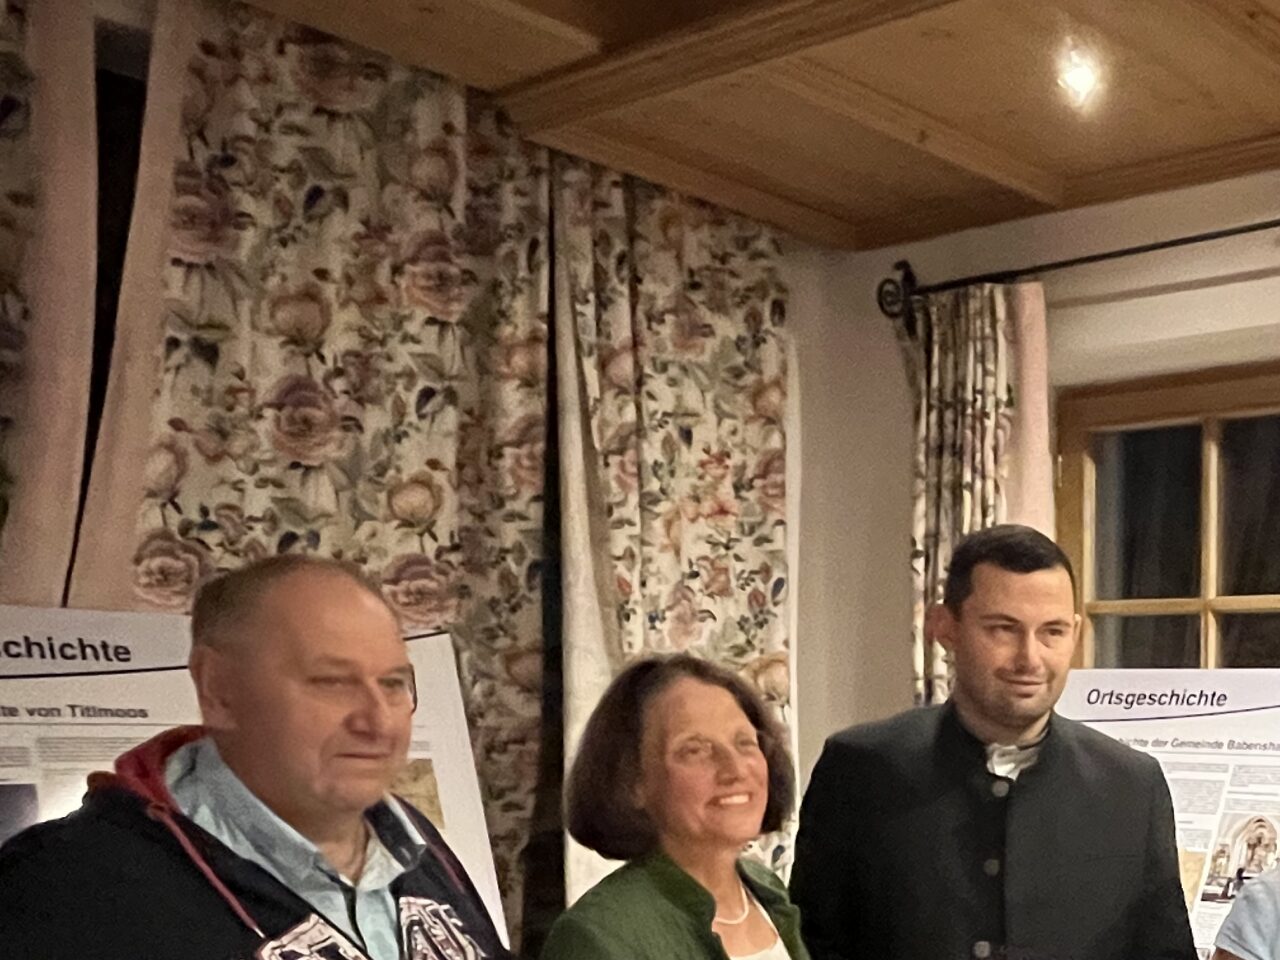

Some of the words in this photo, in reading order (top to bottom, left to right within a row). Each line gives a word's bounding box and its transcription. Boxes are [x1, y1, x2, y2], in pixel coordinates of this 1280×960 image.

[0, 636, 131, 662] chichte
[1087, 688, 1228, 709] Ortsgeschichte
[25, 707, 61, 717] von
[1151, 738, 1169, 748] der
[1171, 738, 1224, 749] Gemeinde
